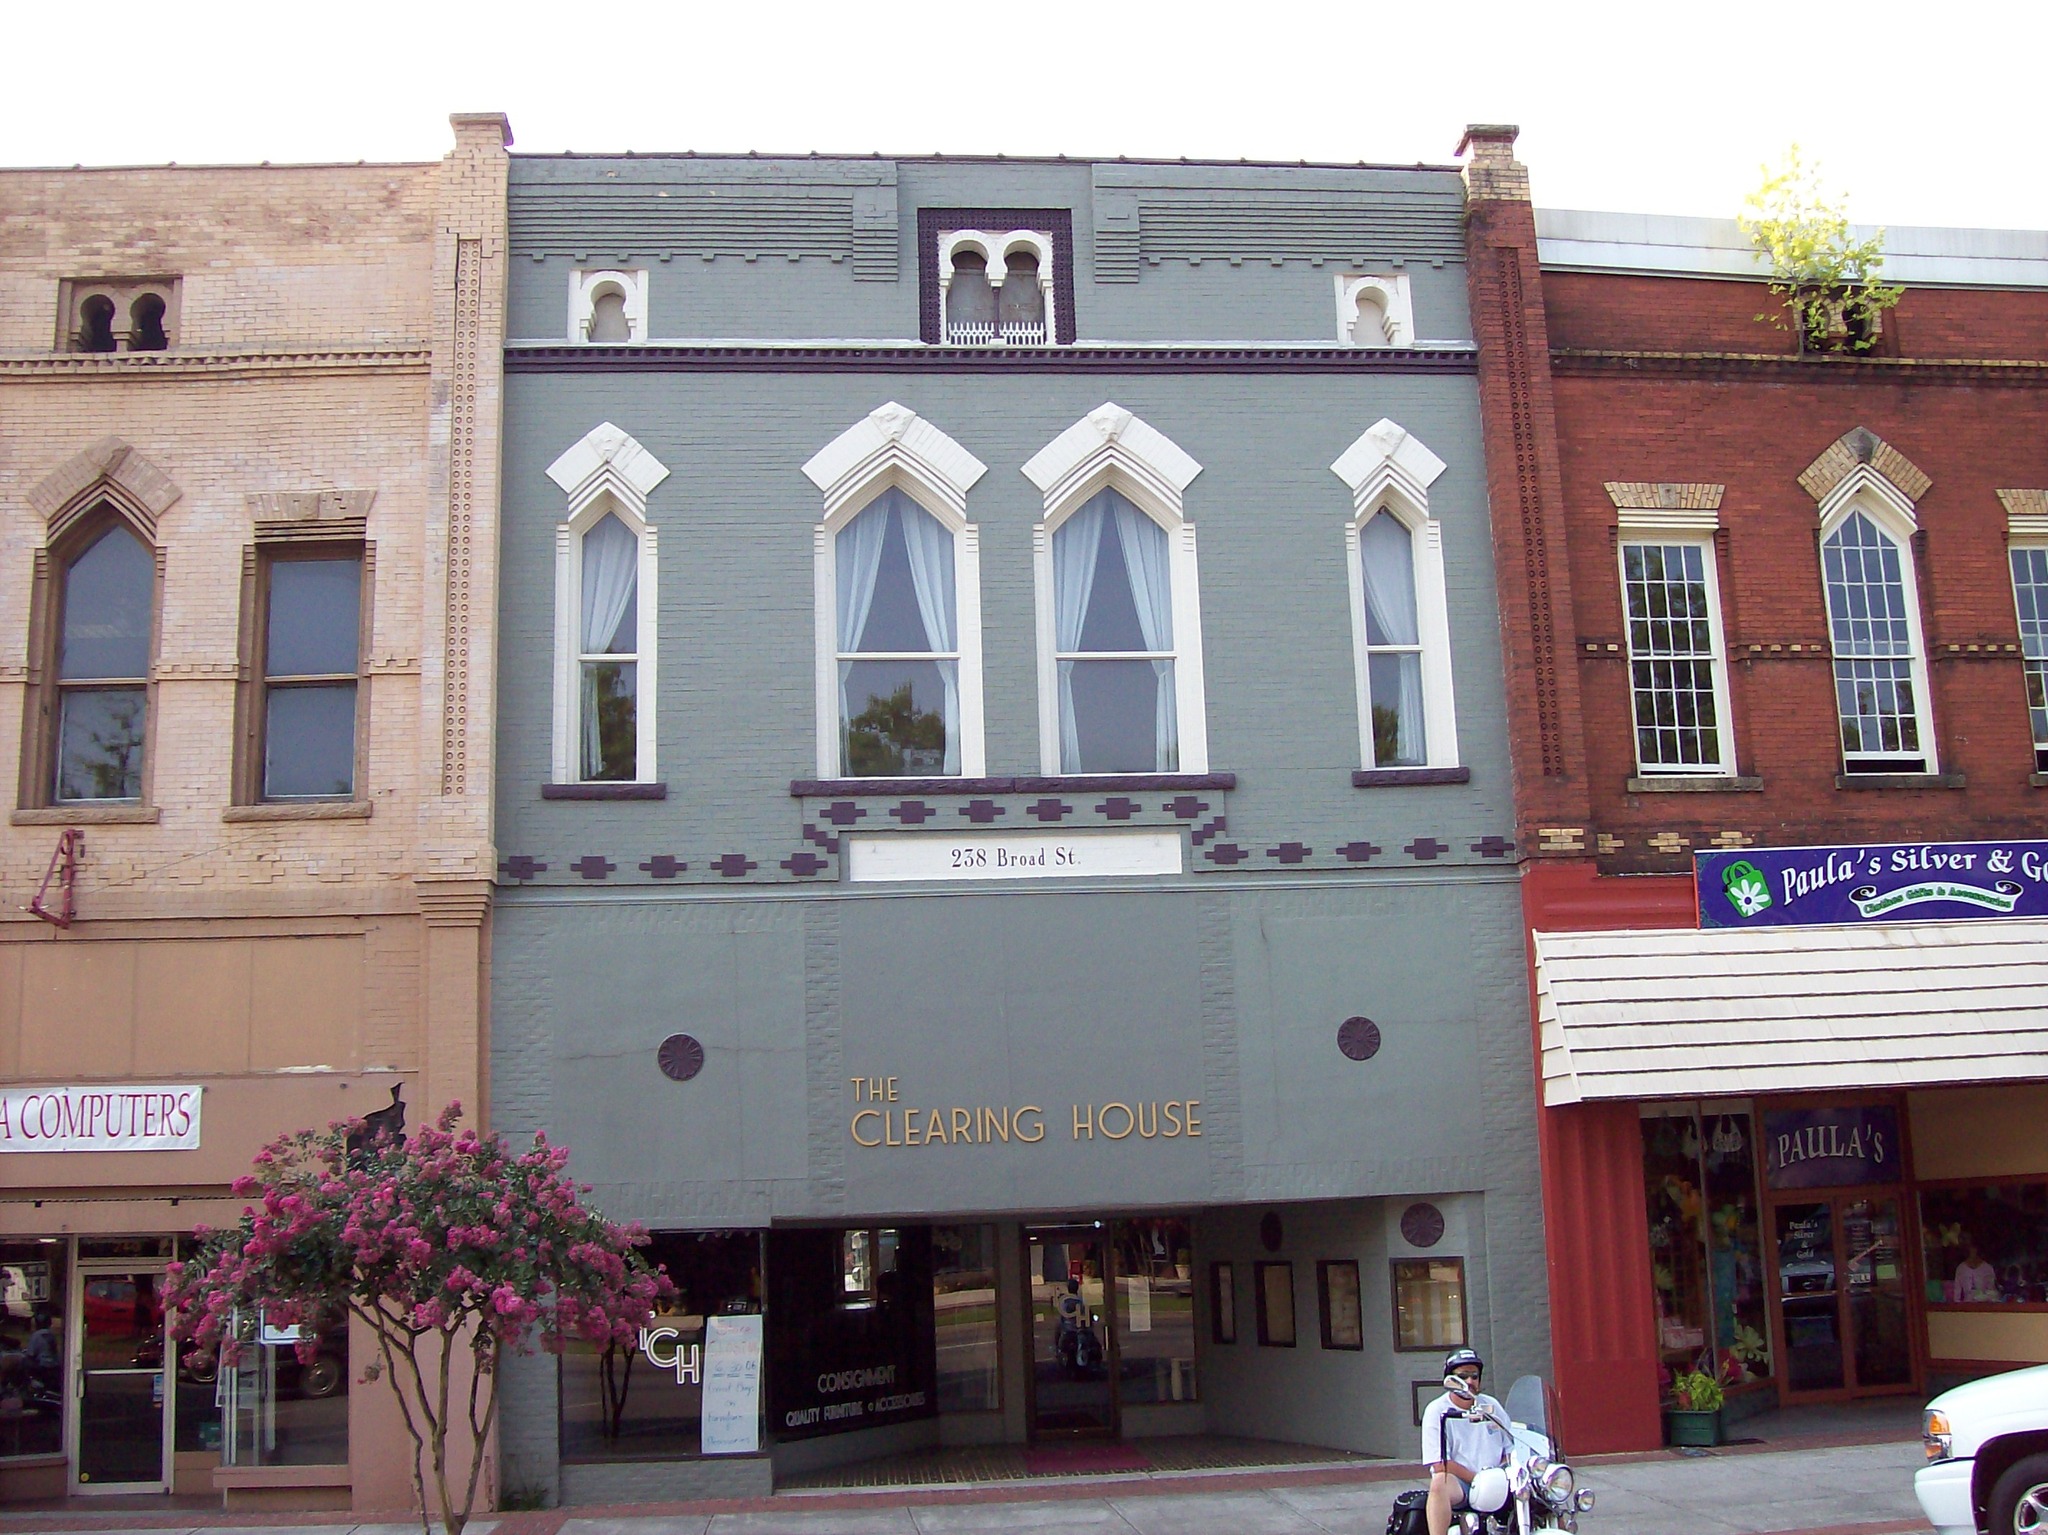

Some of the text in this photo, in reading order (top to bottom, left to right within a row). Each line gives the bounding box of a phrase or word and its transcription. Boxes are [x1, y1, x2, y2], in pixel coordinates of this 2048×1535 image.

[951, 846, 1082, 868] 238 Broad St.
[1781, 849, 1881, 905] Paula's
[1890, 846, 1977, 872] Silver
[1987, 849, 2014, 873] &
[851, 1077, 899, 1102] THE
[20, 1092, 190, 1140] COMPUTERS
[850, 1100, 1203, 1147] CLEARING HOUSE
[1777, 1123, 1885, 1169] PAULA'S
[817, 1365, 896, 1393] CONSIGNMENT
[785, 1407, 821, 1427] QUALITY
